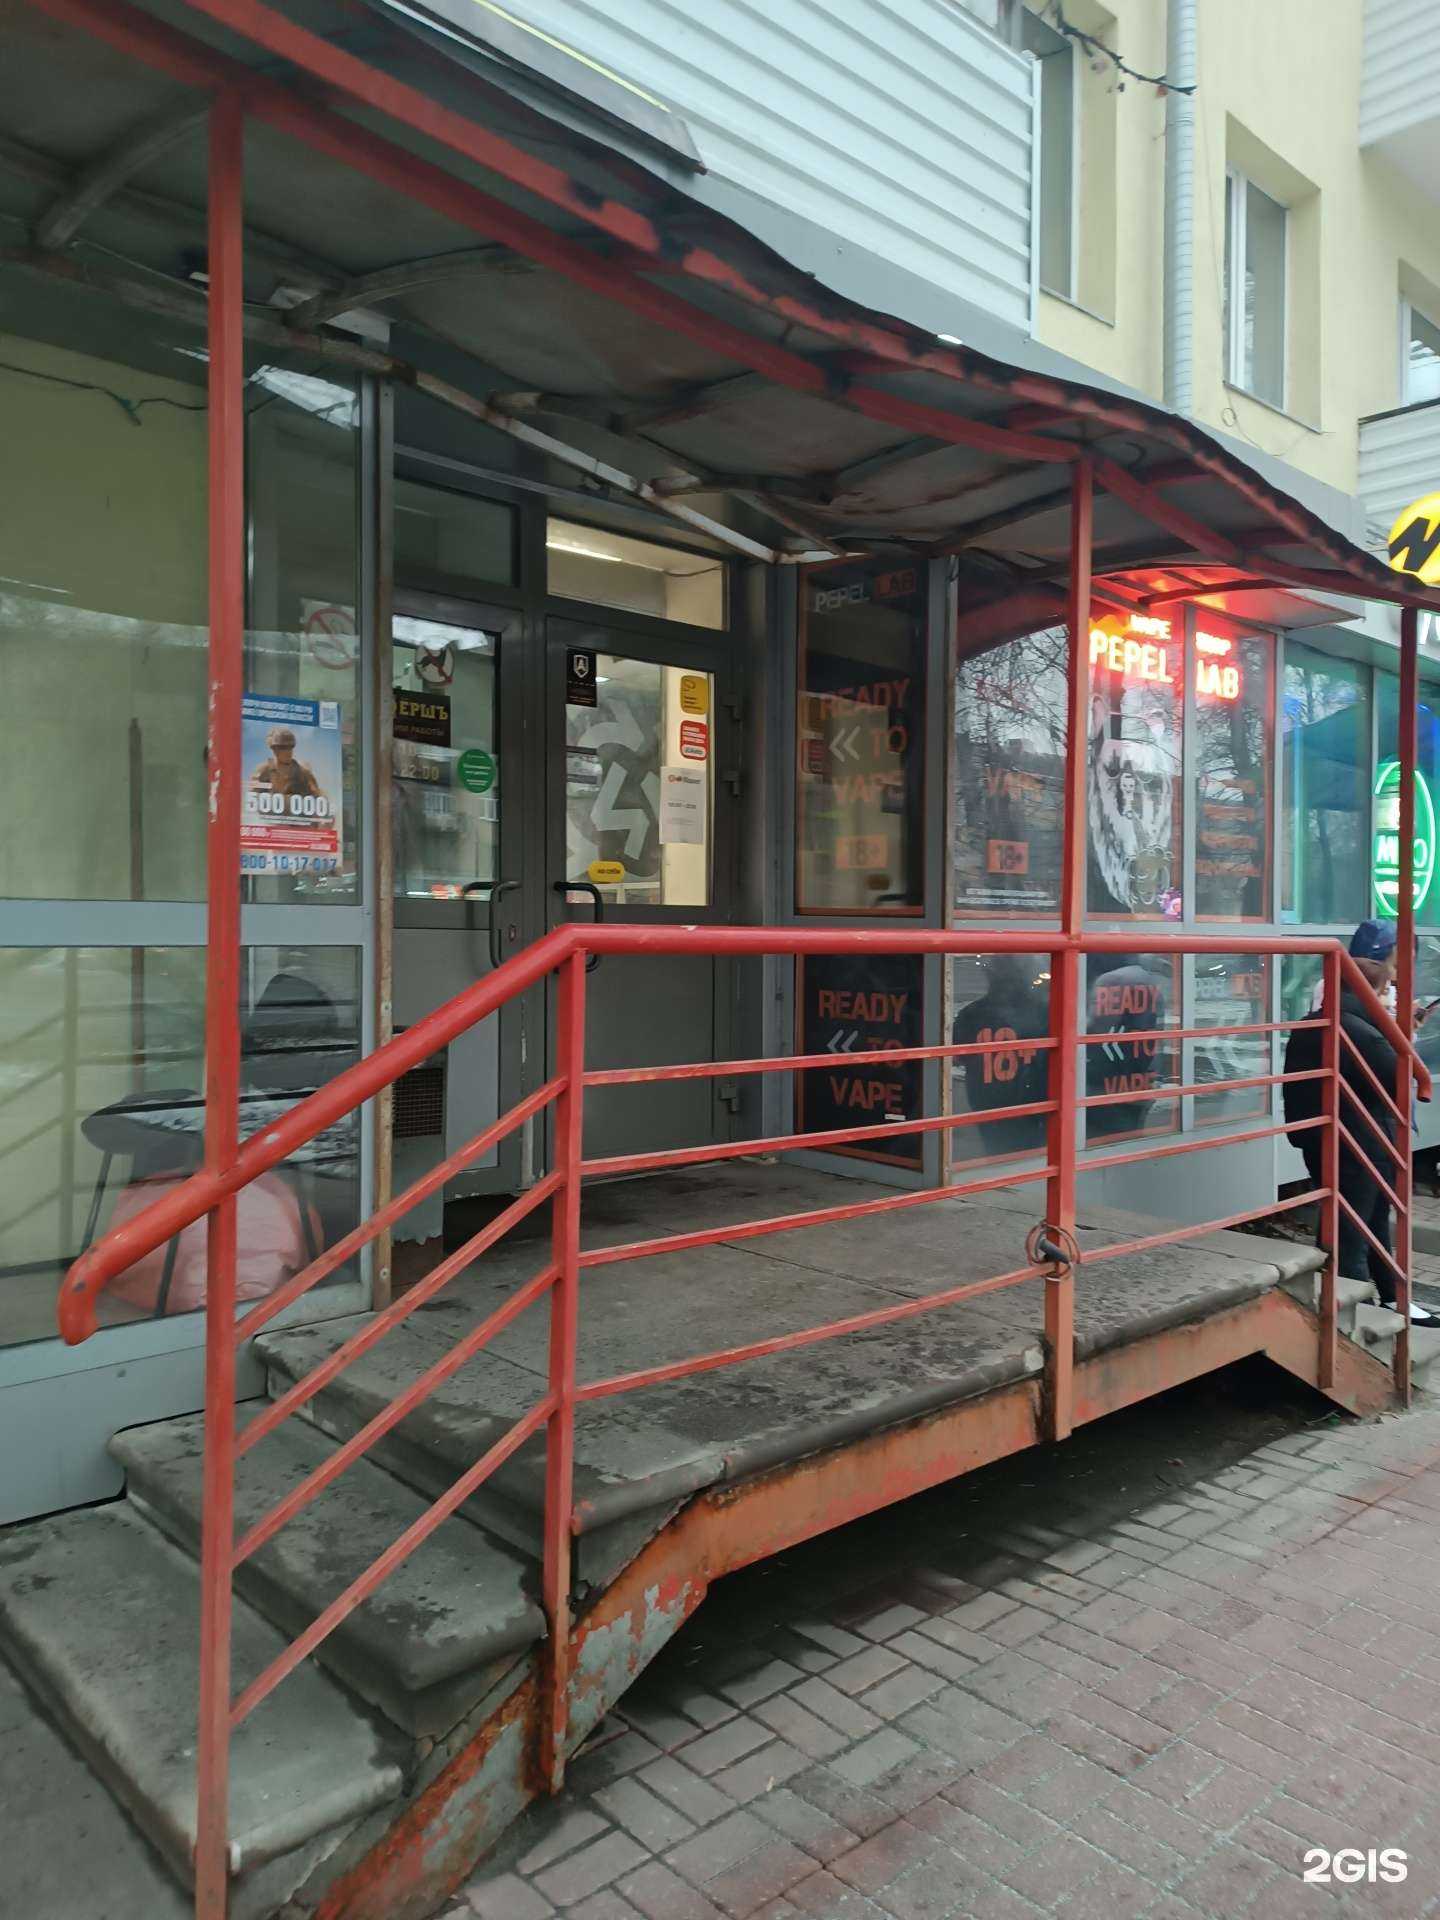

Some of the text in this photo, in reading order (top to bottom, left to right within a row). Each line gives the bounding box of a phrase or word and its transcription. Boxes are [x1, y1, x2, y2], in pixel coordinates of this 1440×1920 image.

[1089, 628, 1240, 700] PEPEL LAB
[290, 795, 328, 817] 000
[818, 990, 908, 1024] READY
[1096, 984, 1160, 1016] READY
[864, 1036, 905, 1068] TO
[976, 1027, 1037, 1084] 18+
[1131, 1030, 1157, 1058] TO
[830, 1075, 904, 1114] VAPE
